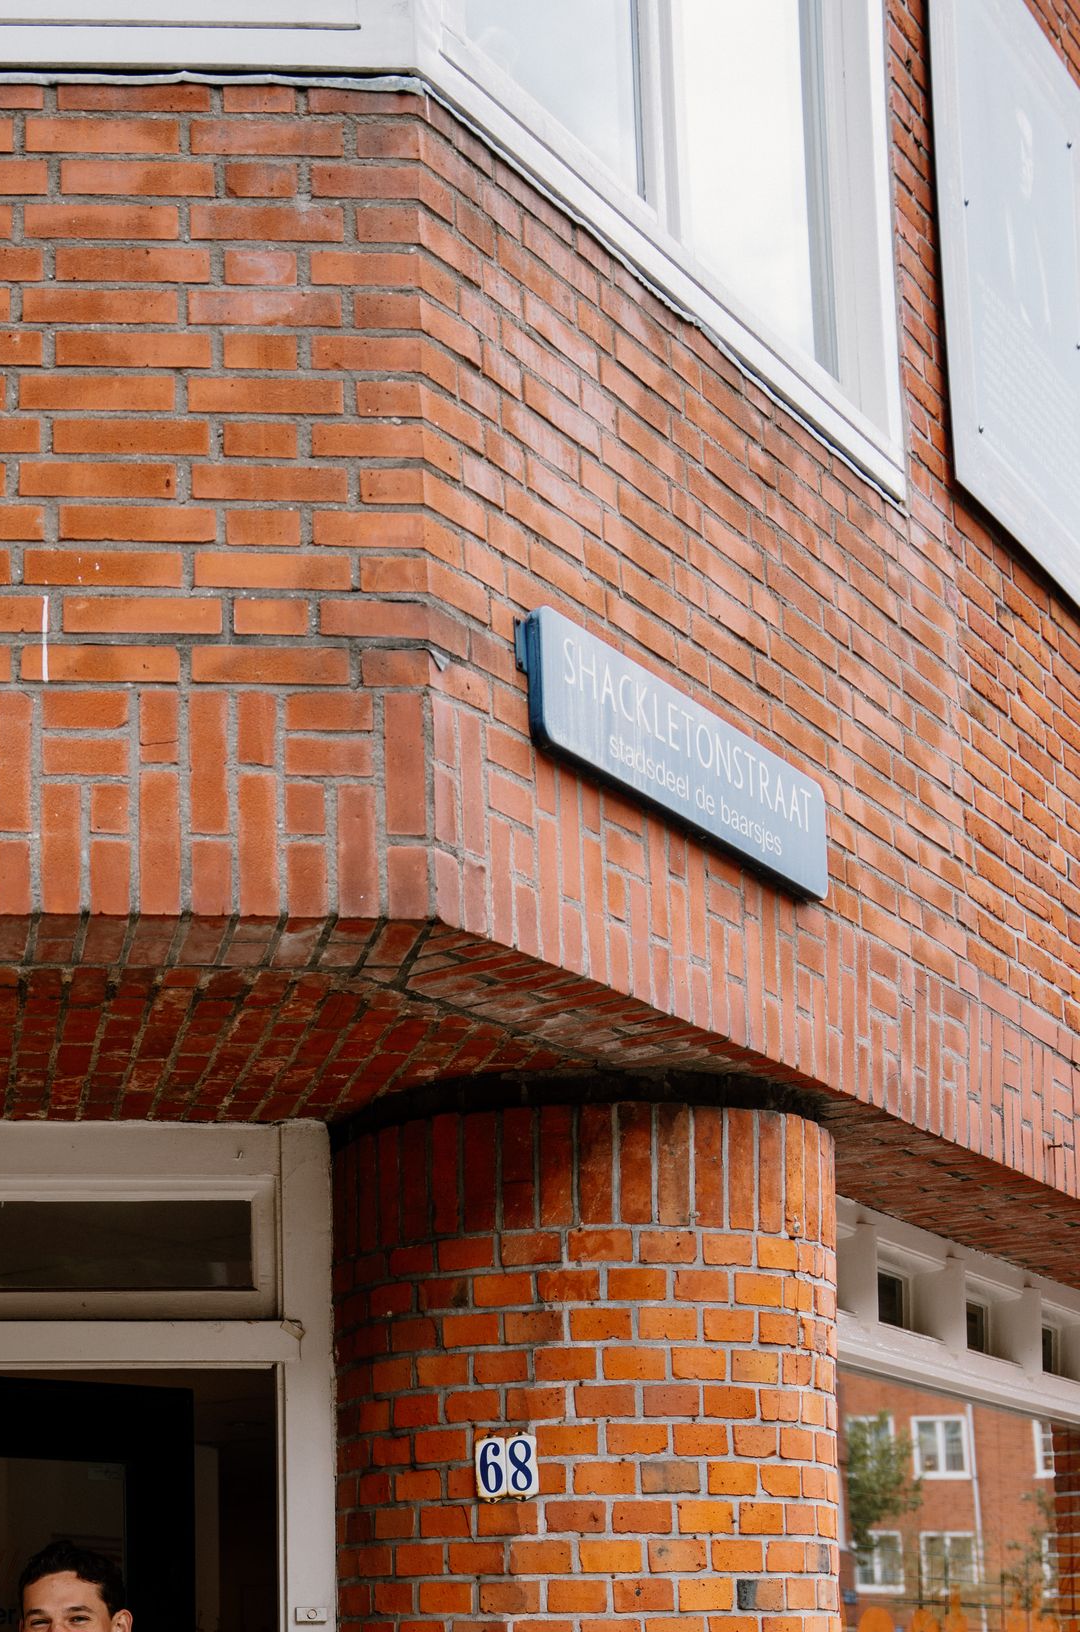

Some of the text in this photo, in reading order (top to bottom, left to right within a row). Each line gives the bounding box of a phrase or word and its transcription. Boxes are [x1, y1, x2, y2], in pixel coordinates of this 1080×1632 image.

[562, 637, 813, 833] SHACKLETONSTRAAT
[608, 735, 783, 857] stadsdeel de baarsjes
[479, 1438, 533, 1493] 68
